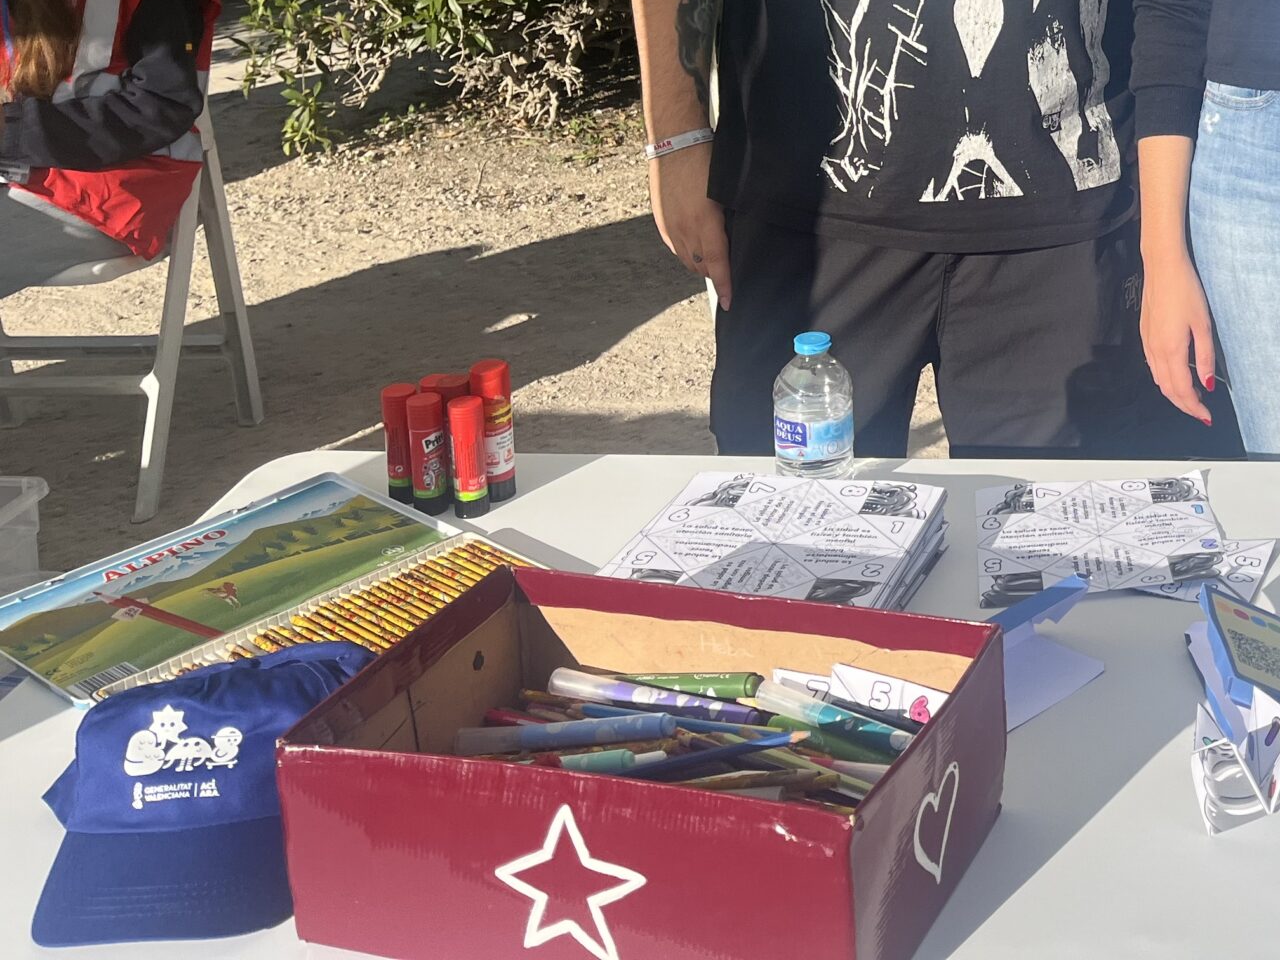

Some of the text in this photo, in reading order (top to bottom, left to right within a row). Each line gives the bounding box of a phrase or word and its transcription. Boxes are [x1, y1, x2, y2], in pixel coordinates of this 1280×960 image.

[775, 420, 803, 434] AQUA
[776, 430, 802, 443] DEUS
[748, 481, 776, 493] 7
[840, 485, 868, 497] 8
[1035, 487, 1061, 498] 7
[1121, 481, 1147, 491] 8
[890, 520, 905, 534] 1
[1199, 538, 1219, 549] 2
[102, 529, 228, 584] ALPINO
[631, 550, 657, 566] 5
[861, 563, 884, 577] 2
[983, 557, 1002, 573] 5
[806, 679, 830, 702] 7
[868, 680, 892, 712] 5
[908, 695, 930, 724] 6
[144, 783, 192, 794] GENERALITAT
[144, 791, 190, 802] VALENCIANA
